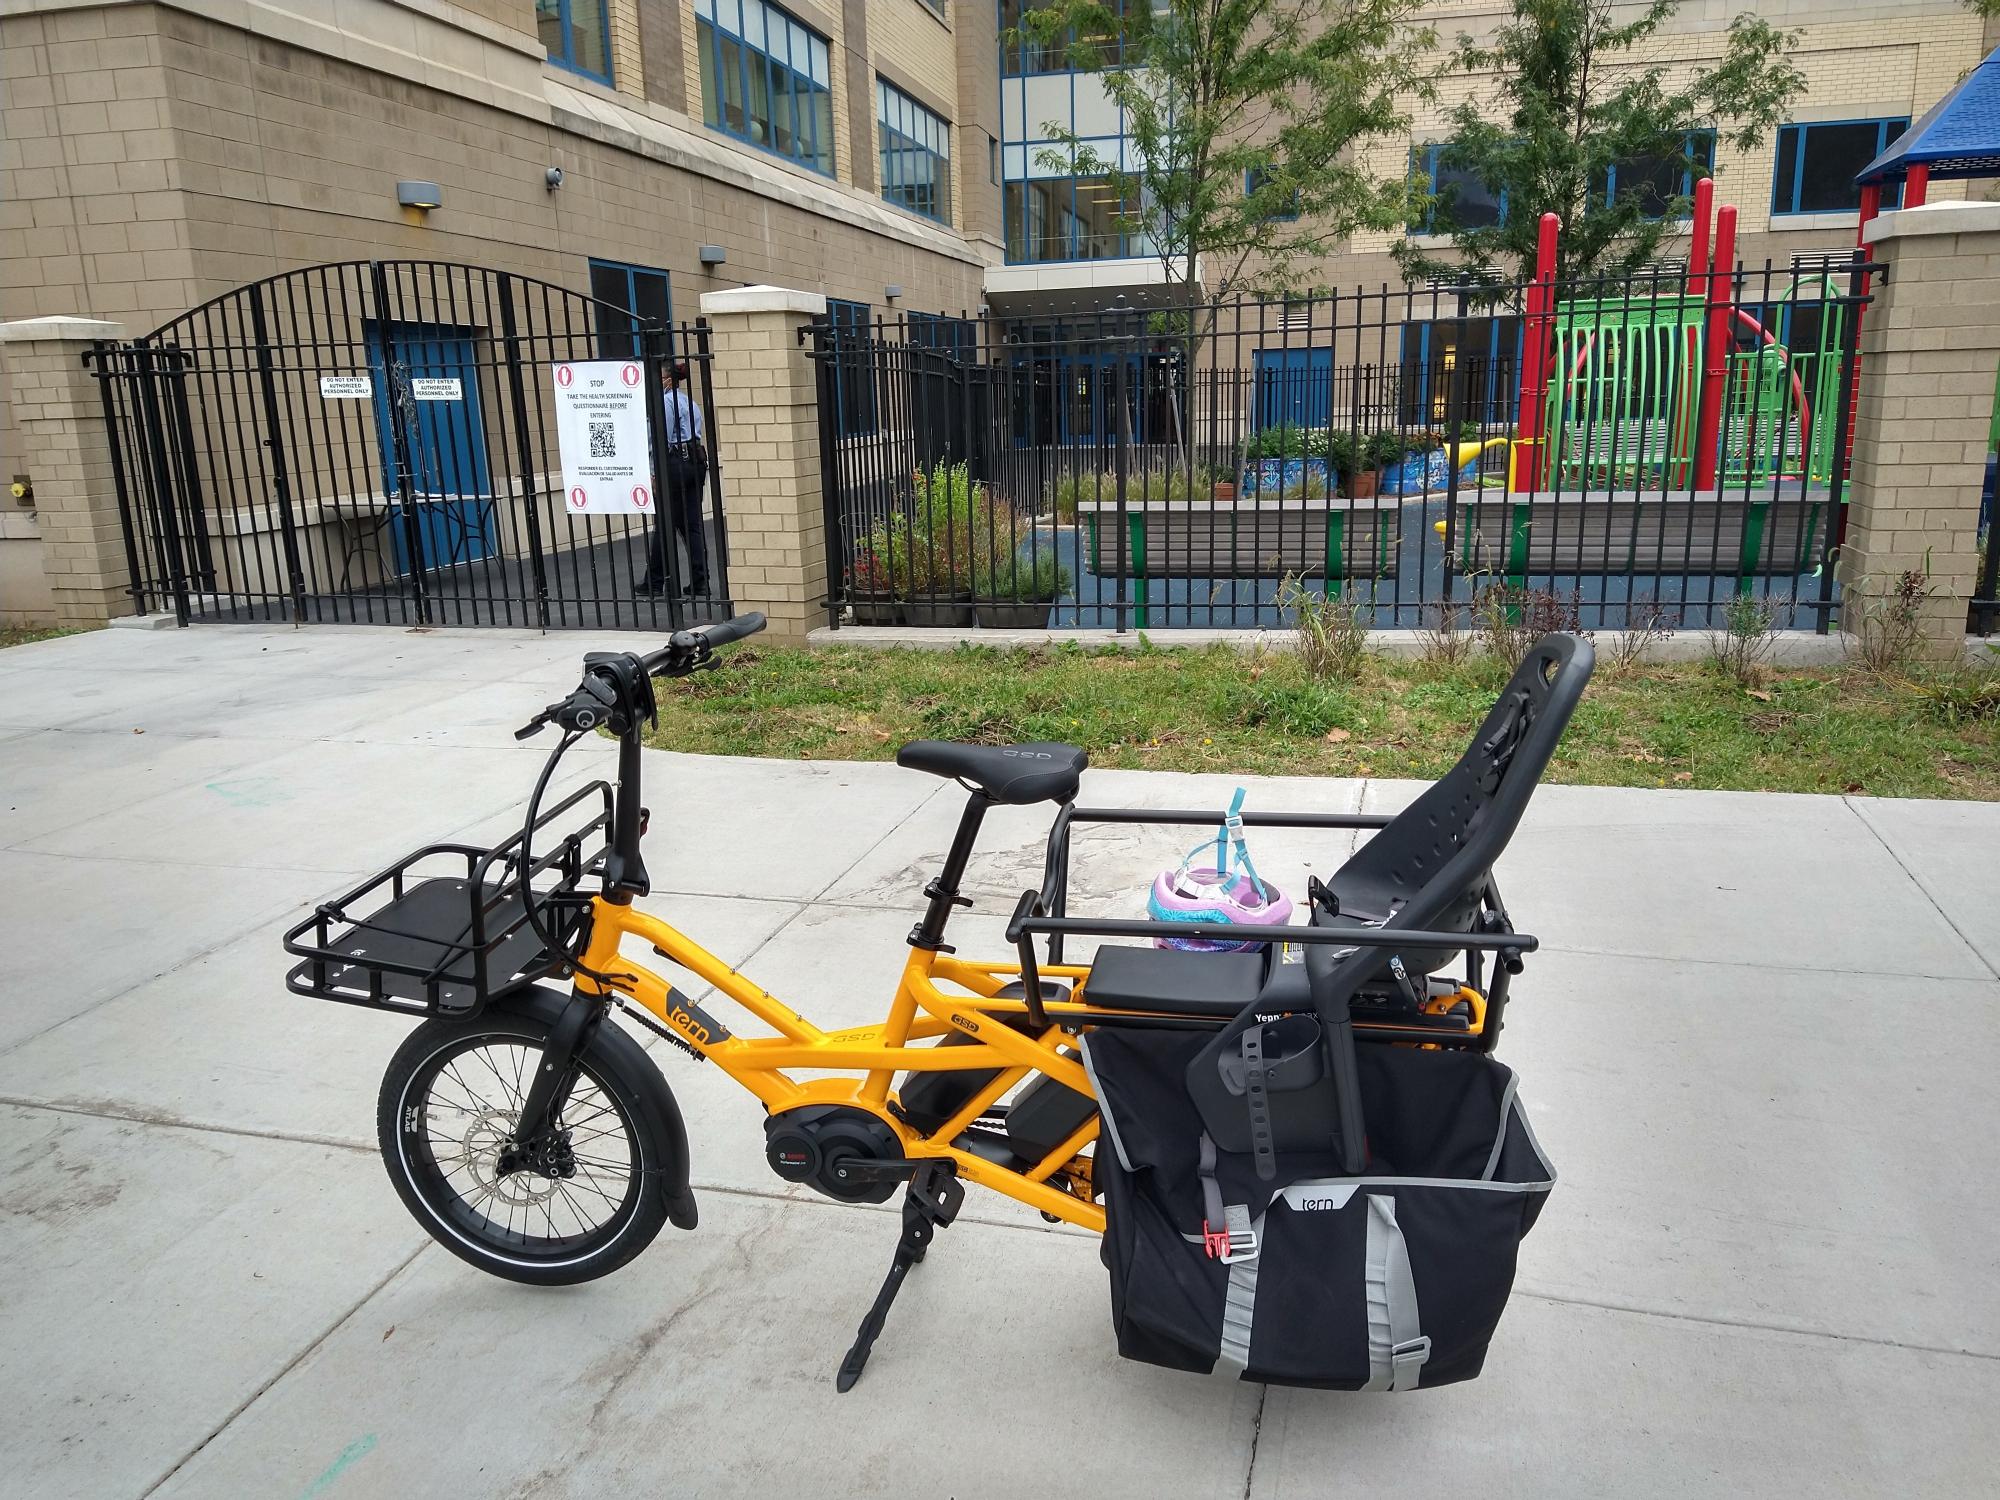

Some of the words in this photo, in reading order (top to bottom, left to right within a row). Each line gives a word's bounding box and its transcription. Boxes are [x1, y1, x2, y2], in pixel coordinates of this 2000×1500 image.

[1002, 750, 1052, 760] GSD
[671, 1006, 710, 1043] tern
[953, 1015, 977, 1031] GSD
[833, 1033, 876, 1042] GSD
[1302, 1198, 1334, 1211] tern
